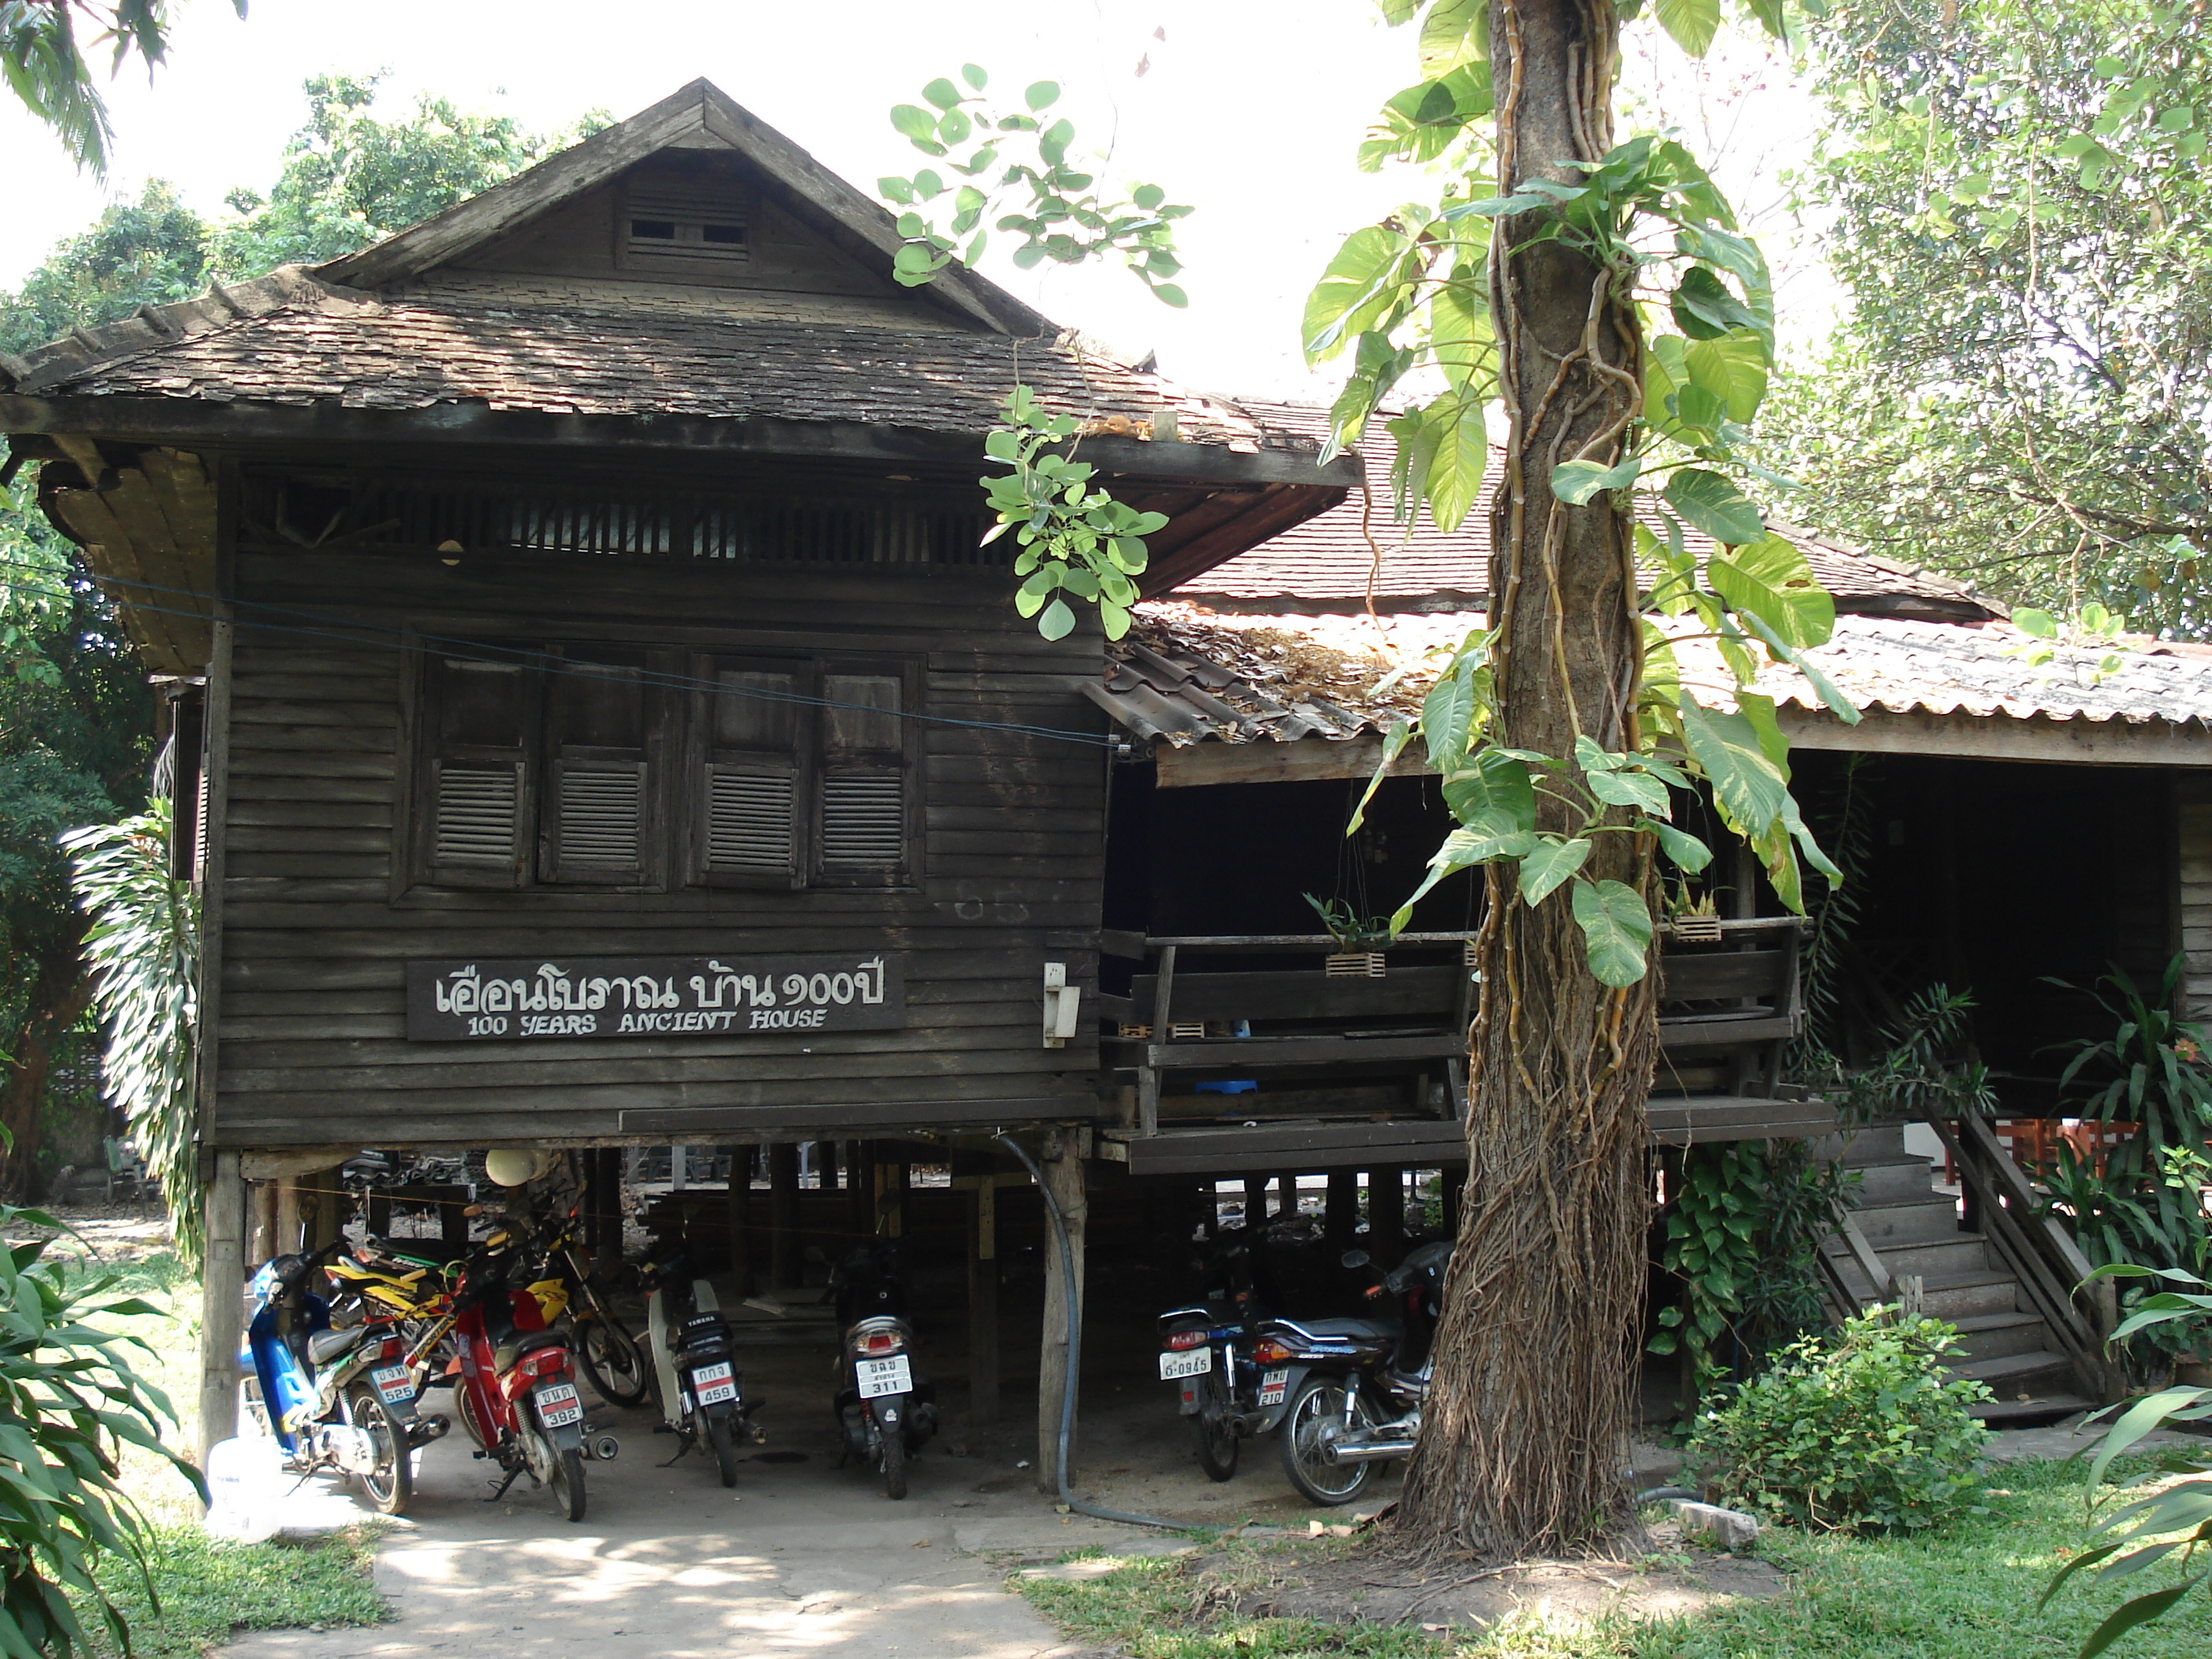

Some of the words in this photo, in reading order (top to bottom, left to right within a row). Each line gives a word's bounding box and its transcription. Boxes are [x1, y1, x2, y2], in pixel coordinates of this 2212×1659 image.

[468, 1016, 508, 1036] 100
[519, 1014, 598, 1037] YEARS
[616, 1011, 738, 1034] ANCIENT
[749, 1009, 828, 1030] HOUSE
[687, 1315, 716, 1328] YAMAHA
[385, 1386, 413, 1401] 525
[705, 1386, 731, 1402] 459
[873, 1381, 898, 1393] 311
[1262, 1392, 1282, 1405] 210
[548, 1409, 577, 1426] 392
